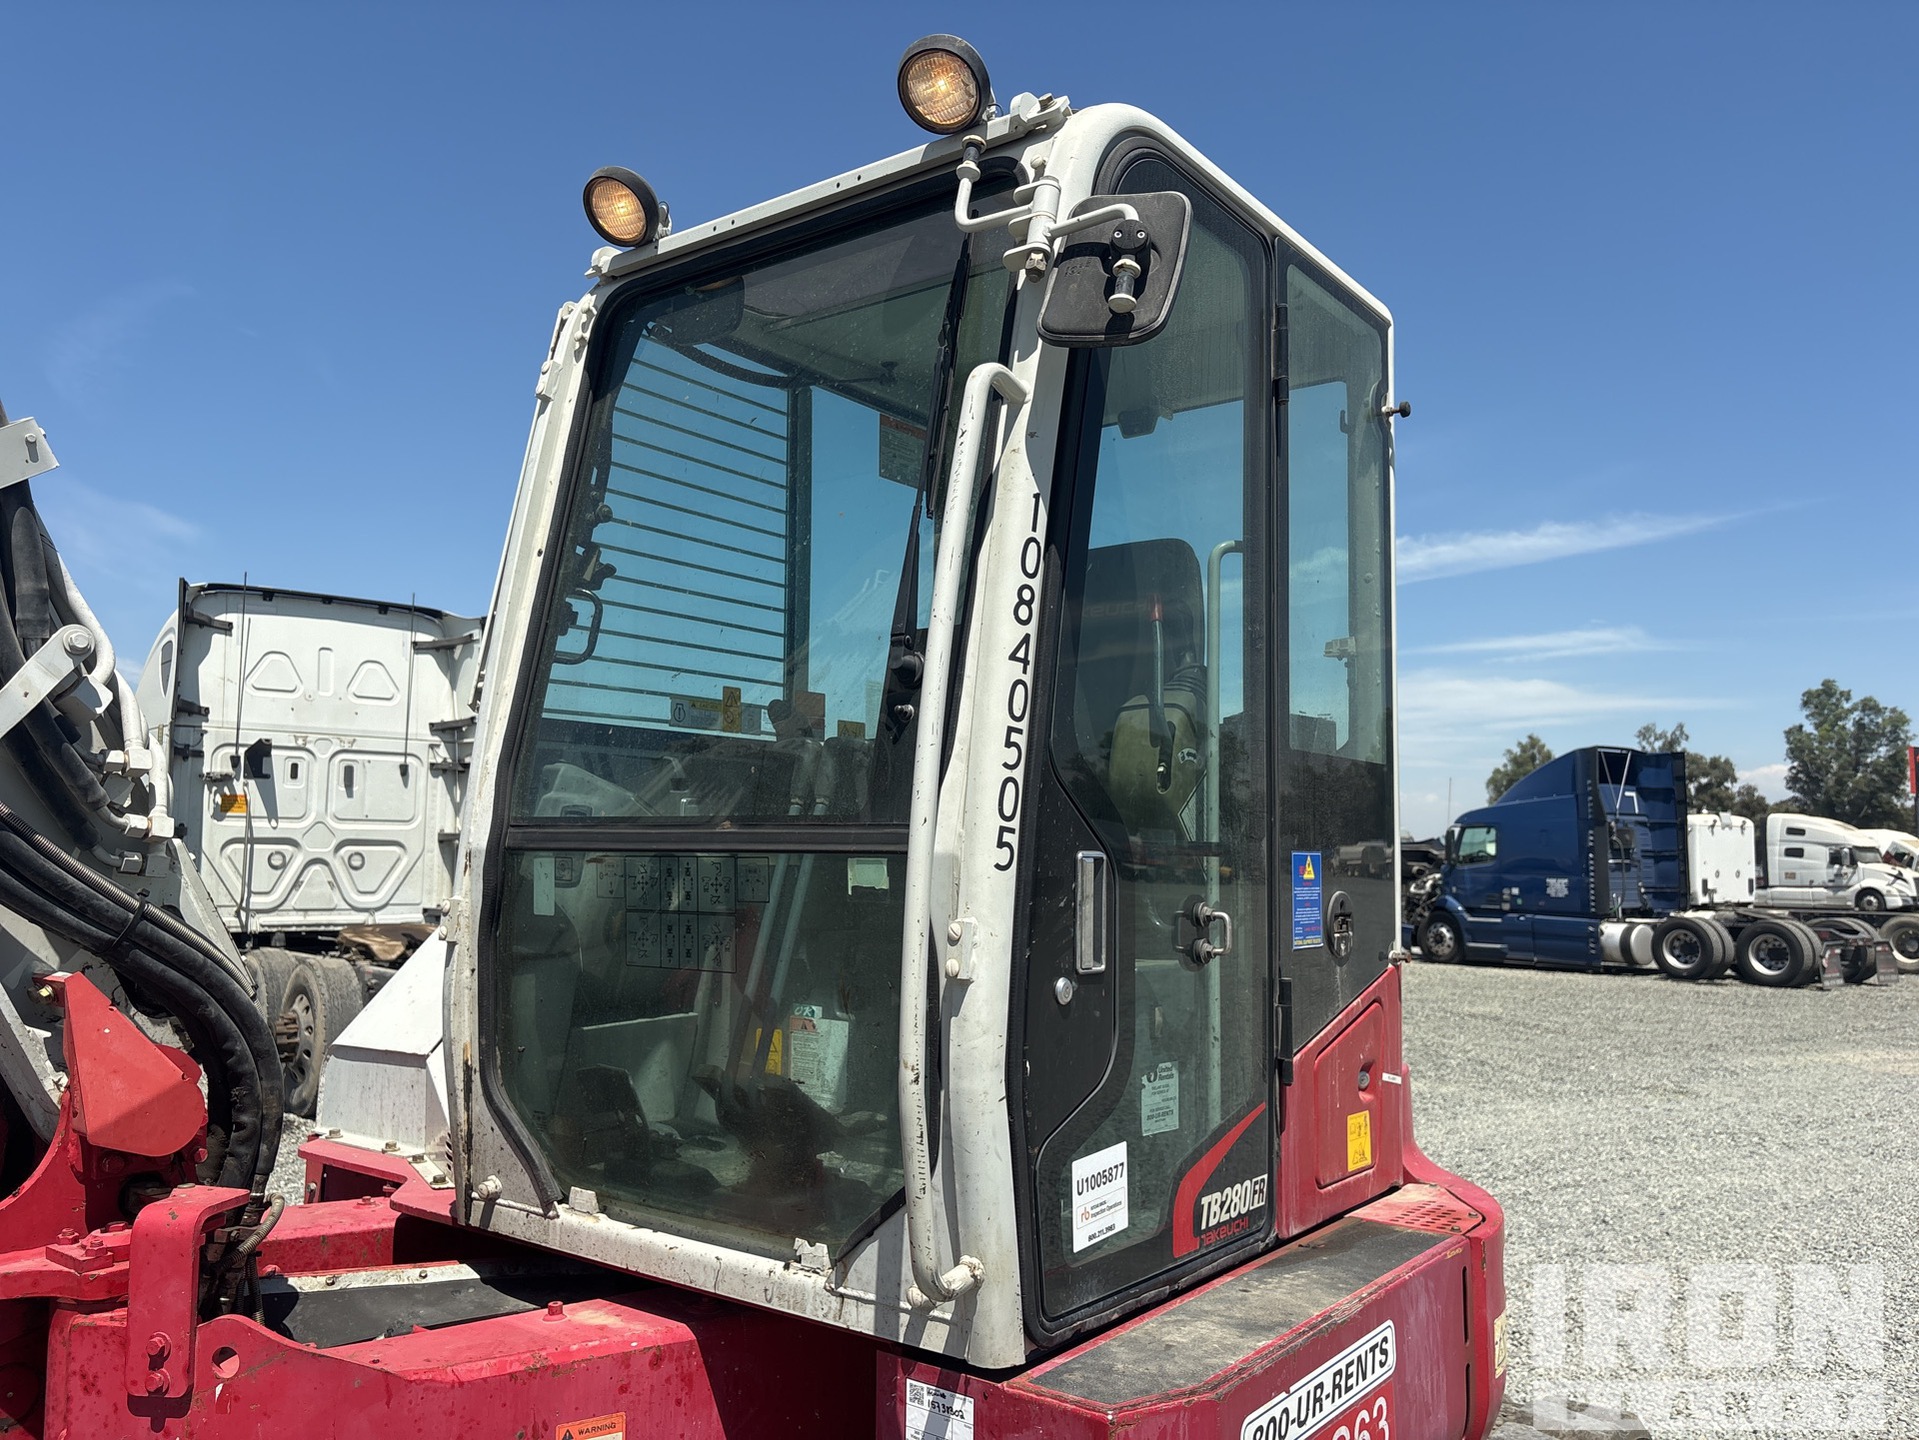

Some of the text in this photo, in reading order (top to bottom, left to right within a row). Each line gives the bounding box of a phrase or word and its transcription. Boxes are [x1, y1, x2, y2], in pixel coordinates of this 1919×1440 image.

[994, 493, 1041, 872] 10840505
[1076, 1162, 1125, 1196] U1005877
[578, 1422, 616, 1436] WARNING
